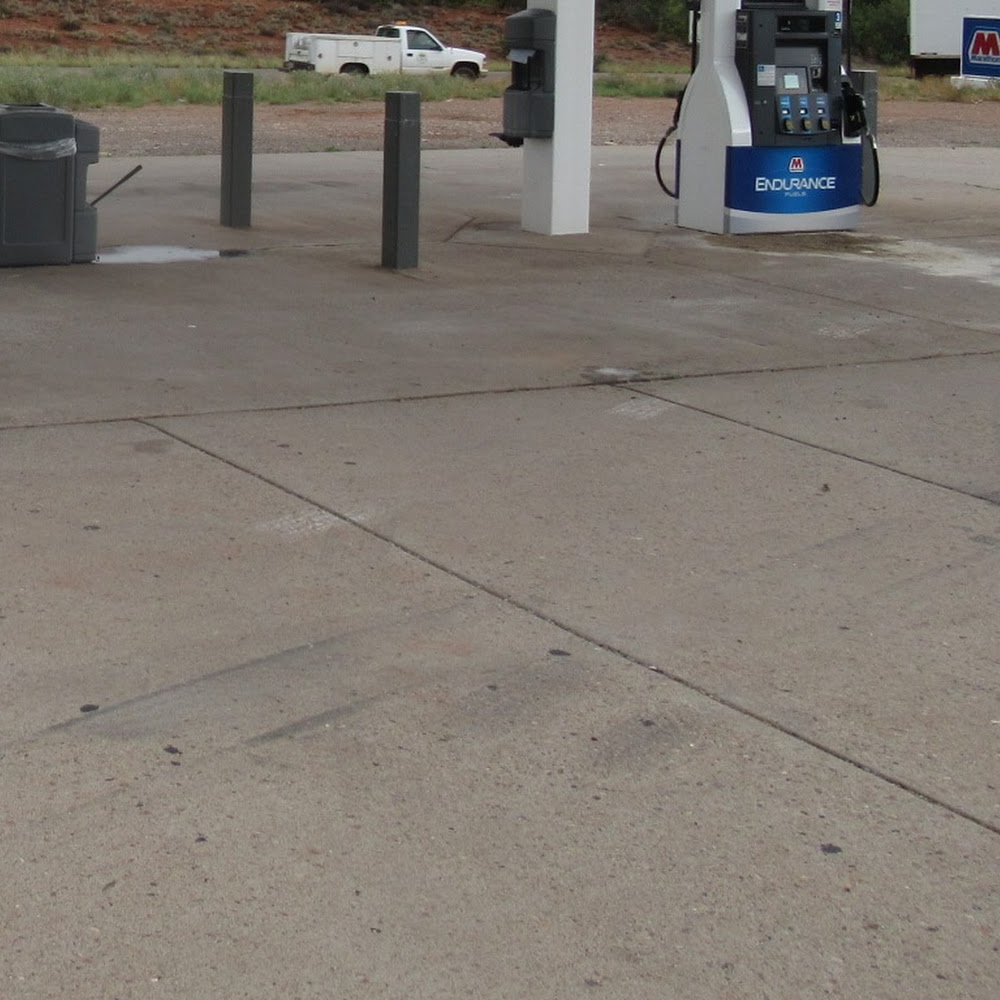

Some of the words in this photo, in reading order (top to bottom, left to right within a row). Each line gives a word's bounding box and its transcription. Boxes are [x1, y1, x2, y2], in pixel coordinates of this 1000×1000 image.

[971, 32, 1000, 55] M
[792, 159, 802, 168] M
[755, 177, 836, 191] ENDURANCE
